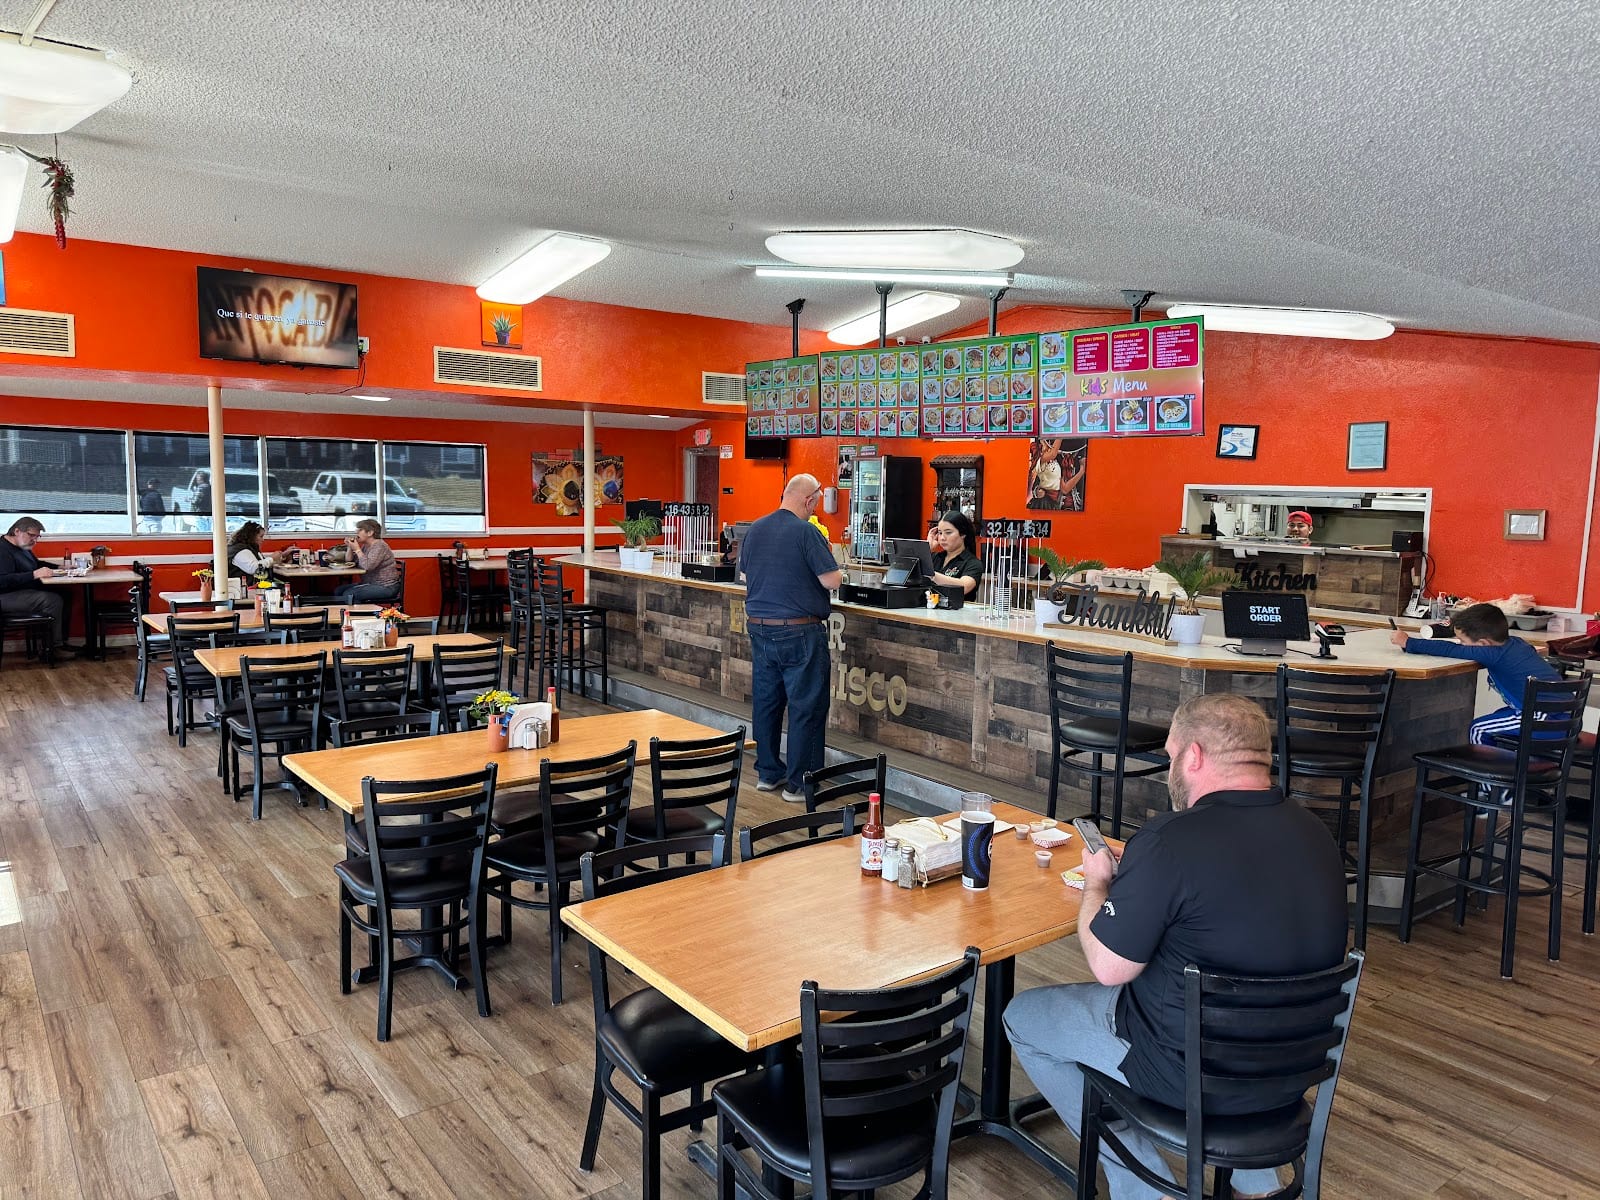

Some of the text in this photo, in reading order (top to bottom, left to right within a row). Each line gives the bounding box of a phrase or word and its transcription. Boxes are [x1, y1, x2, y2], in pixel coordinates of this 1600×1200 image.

[217, 308, 234, 318] Que
[235, 310, 243, 319] si
[245, 311, 252, 320] te
[1112, 377, 1148, 393] Menu
[987, 521, 1003, 536] 32
[1234, 562, 1318, 591] Kitchen
[1049, 582, 1176, 640] Thankful
[1249, 605, 1281, 615] START
[1249, 614, 1282, 623] ORDER
[830, 663, 908, 717] ISCO
